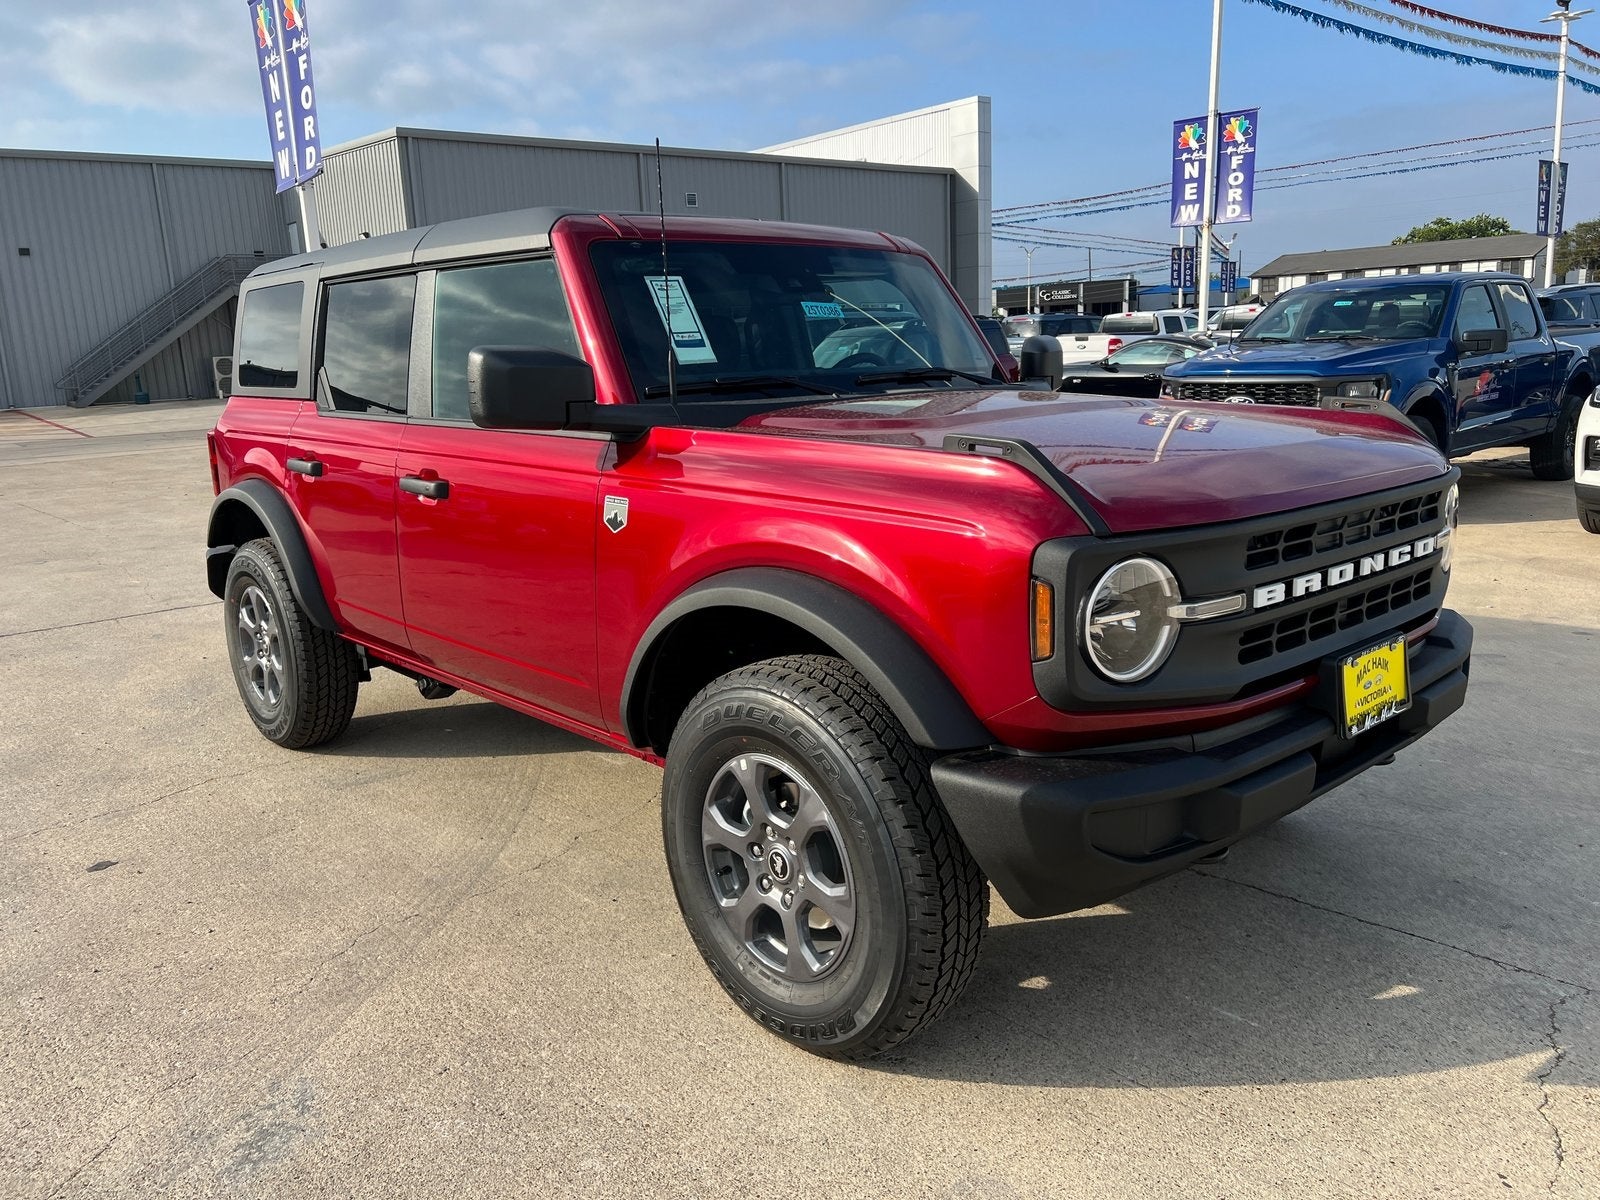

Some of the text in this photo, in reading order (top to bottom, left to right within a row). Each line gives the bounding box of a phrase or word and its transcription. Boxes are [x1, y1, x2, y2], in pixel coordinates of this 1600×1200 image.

[268, 70, 290, 180] NEW
[298, 53, 316, 171] FORD
[1180, 161, 1200, 222] NEW
[1226, 155, 1245, 218] FORD
[1538, 190, 1546, 232] NEW
[805, 304, 840, 316] 25T0386
[1253, 536, 1435, 609] BRONCO
[1356, 656, 1389, 687] MAC HAIK
[702, 702, 841, 782] DUELER
